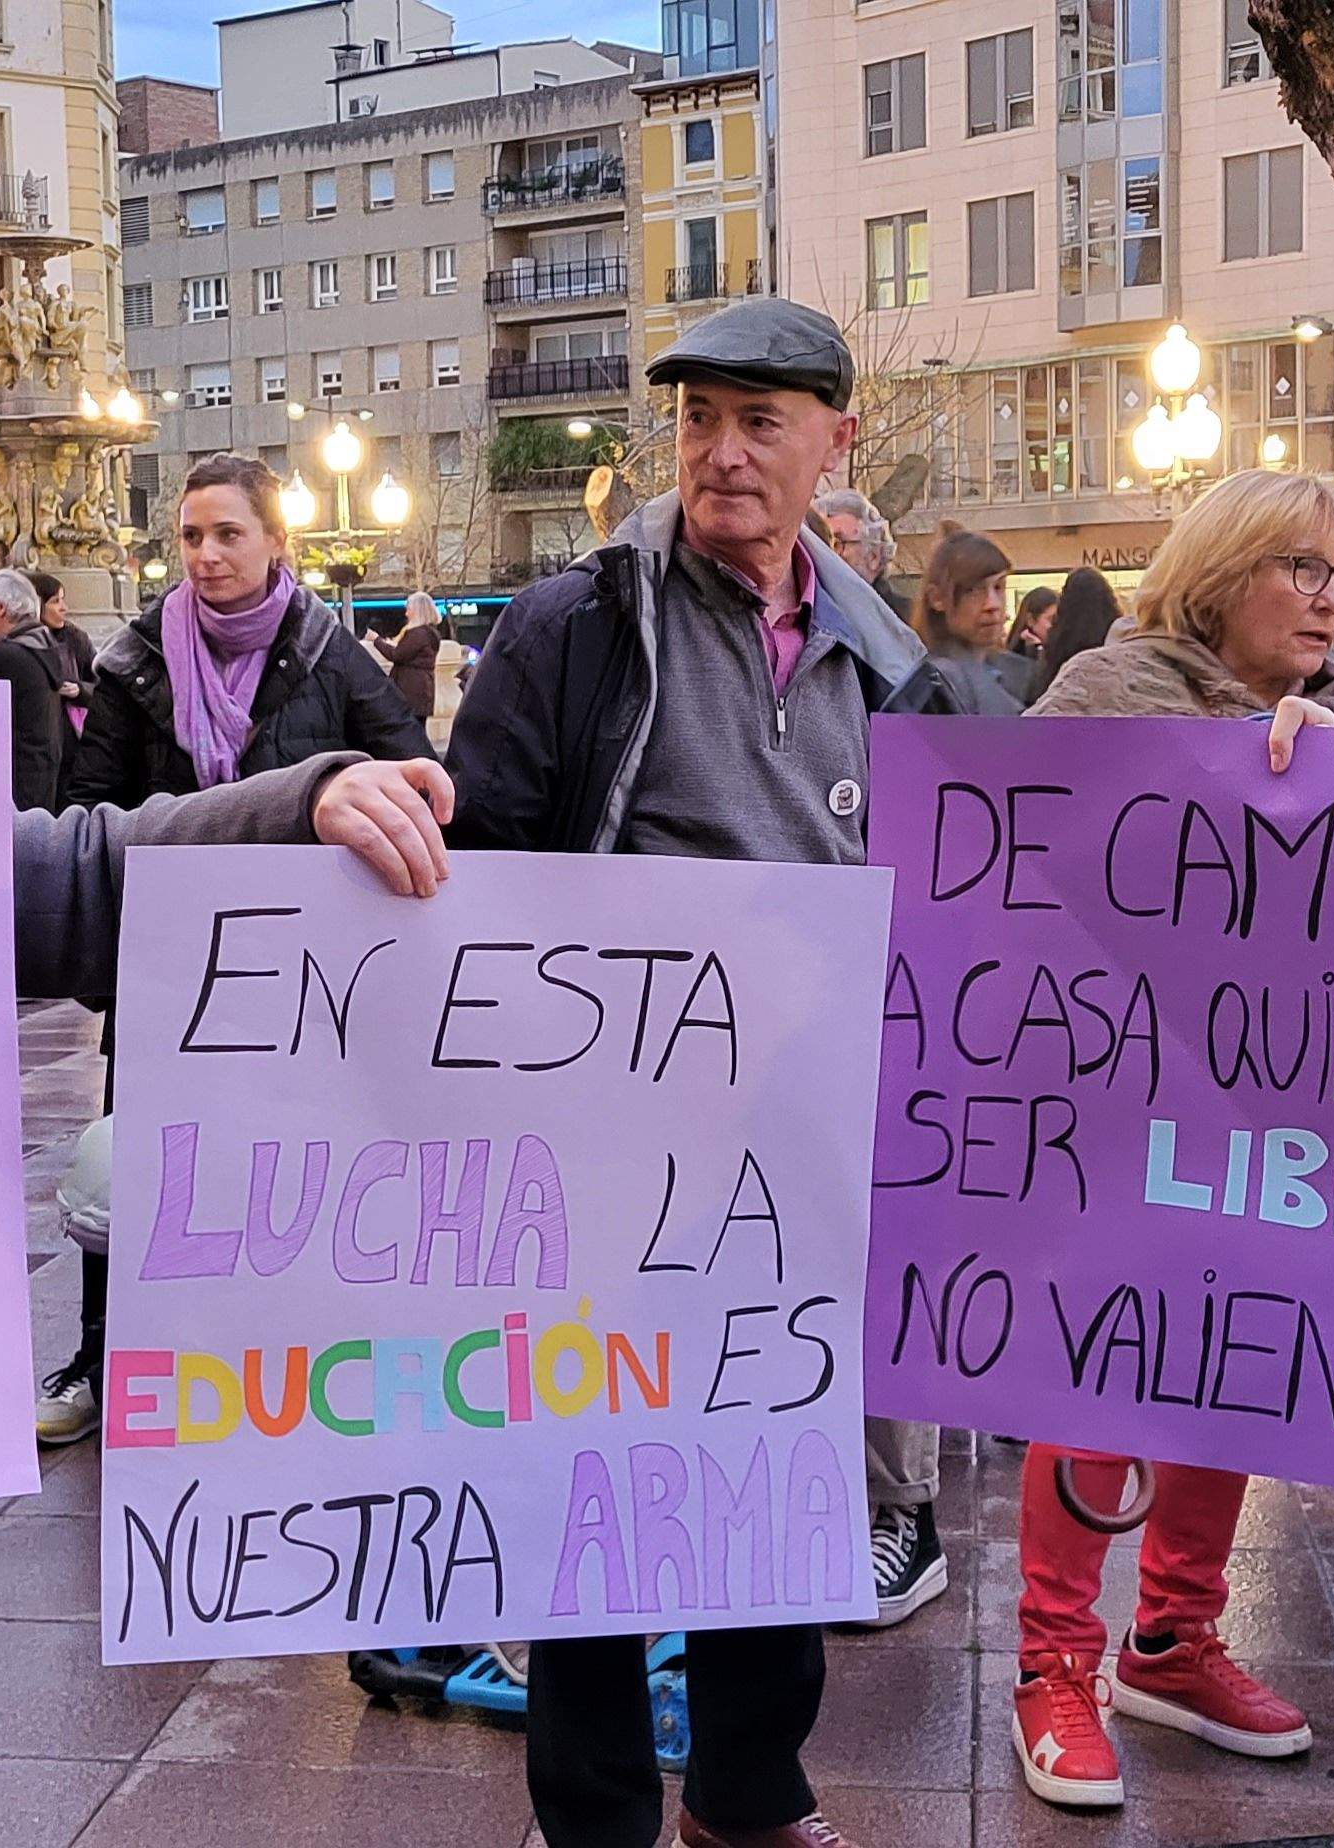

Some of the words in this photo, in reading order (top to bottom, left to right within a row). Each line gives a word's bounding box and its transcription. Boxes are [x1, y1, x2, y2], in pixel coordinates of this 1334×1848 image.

[930, 782, 1073, 911] DE
[179, 907, 397, 1060] EN
[431, 942, 737, 1086] ESTA
[883, 952, 925, 1070] A
[952, 959, 1160, 1105] CASA
[138, 1123, 568, 1289] LUCHA
[638, 1148, 783, 1285] LA
[872, 1089, 1087, 1214] SER
[106, 1295, 670, 1449] EDUCACIÓN
[703, 1295, 838, 1414] ES
[890, 1252, 1013, 1378] NO
[119, 1479, 504, 1643] NUESTRA
[549, 1429, 853, 1617] ARMA
